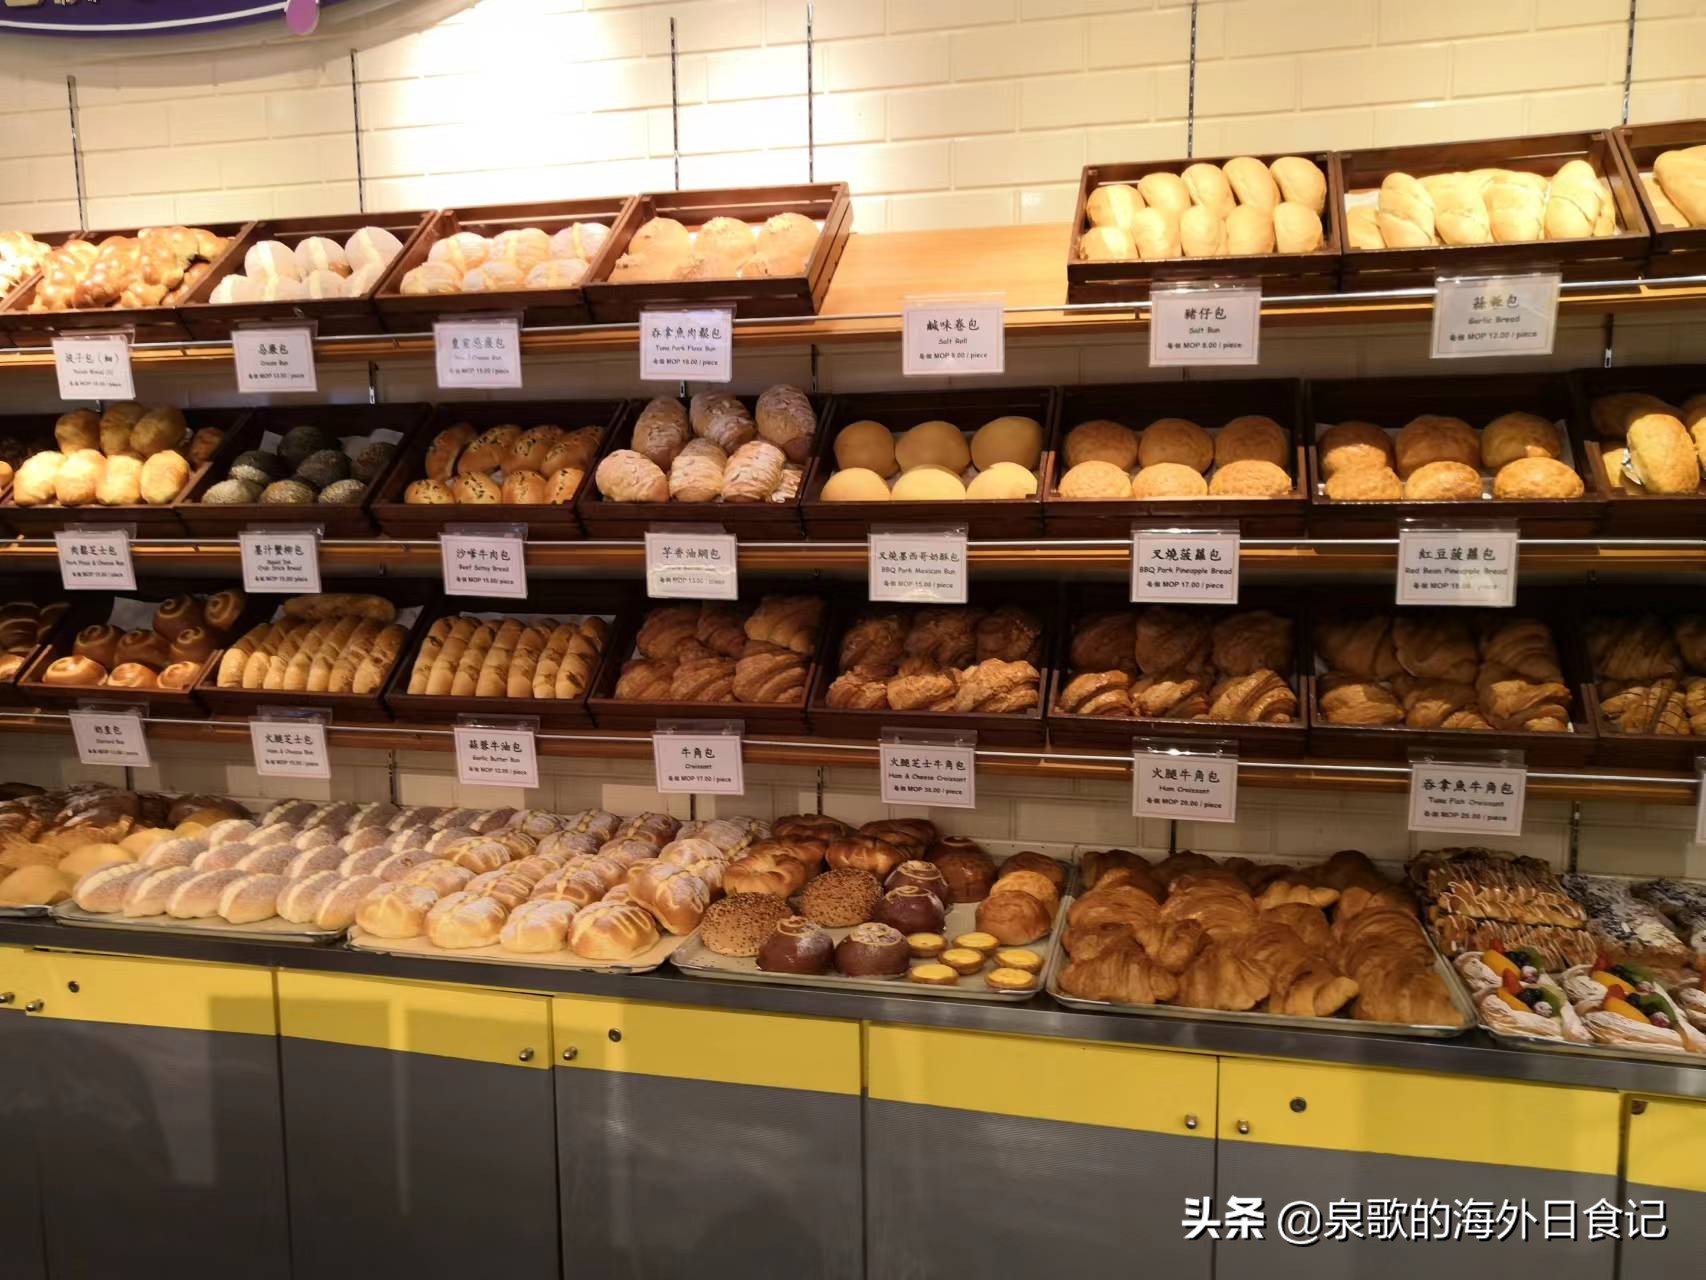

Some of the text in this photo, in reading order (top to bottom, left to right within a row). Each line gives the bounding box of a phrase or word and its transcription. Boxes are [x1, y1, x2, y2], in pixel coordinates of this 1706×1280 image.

[1184, 307, 1227, 320] 豬仔包
[1467, 332, 1487, 340] MOP
[1516, 331, 1537, 339] piece
[1152, 548, 1221, 561] 叉燒菠蘿包
[1418, 548, 1496, 561] 紅豆菠蘿包
[881, 566, 895, 574] BBQ
[1139, 566, 1155, 574] BBQ
[1175, 567, 1208, 575] Pineapple
[265, 734, 314, 745] 火腿芝士包
[681, 746, 716, 758] 牛角包
[889, 758, 966, 770] 火腿芝士牛角包
[1152, 767, 1220, 783] 火腿牛角包
[1177, 786, 1210, 794] Croissant
[1423, 778, 1514, 795] 吞拿魚牛角包
[1428, 796, 1504, 807] Tuna Fish Croissant
